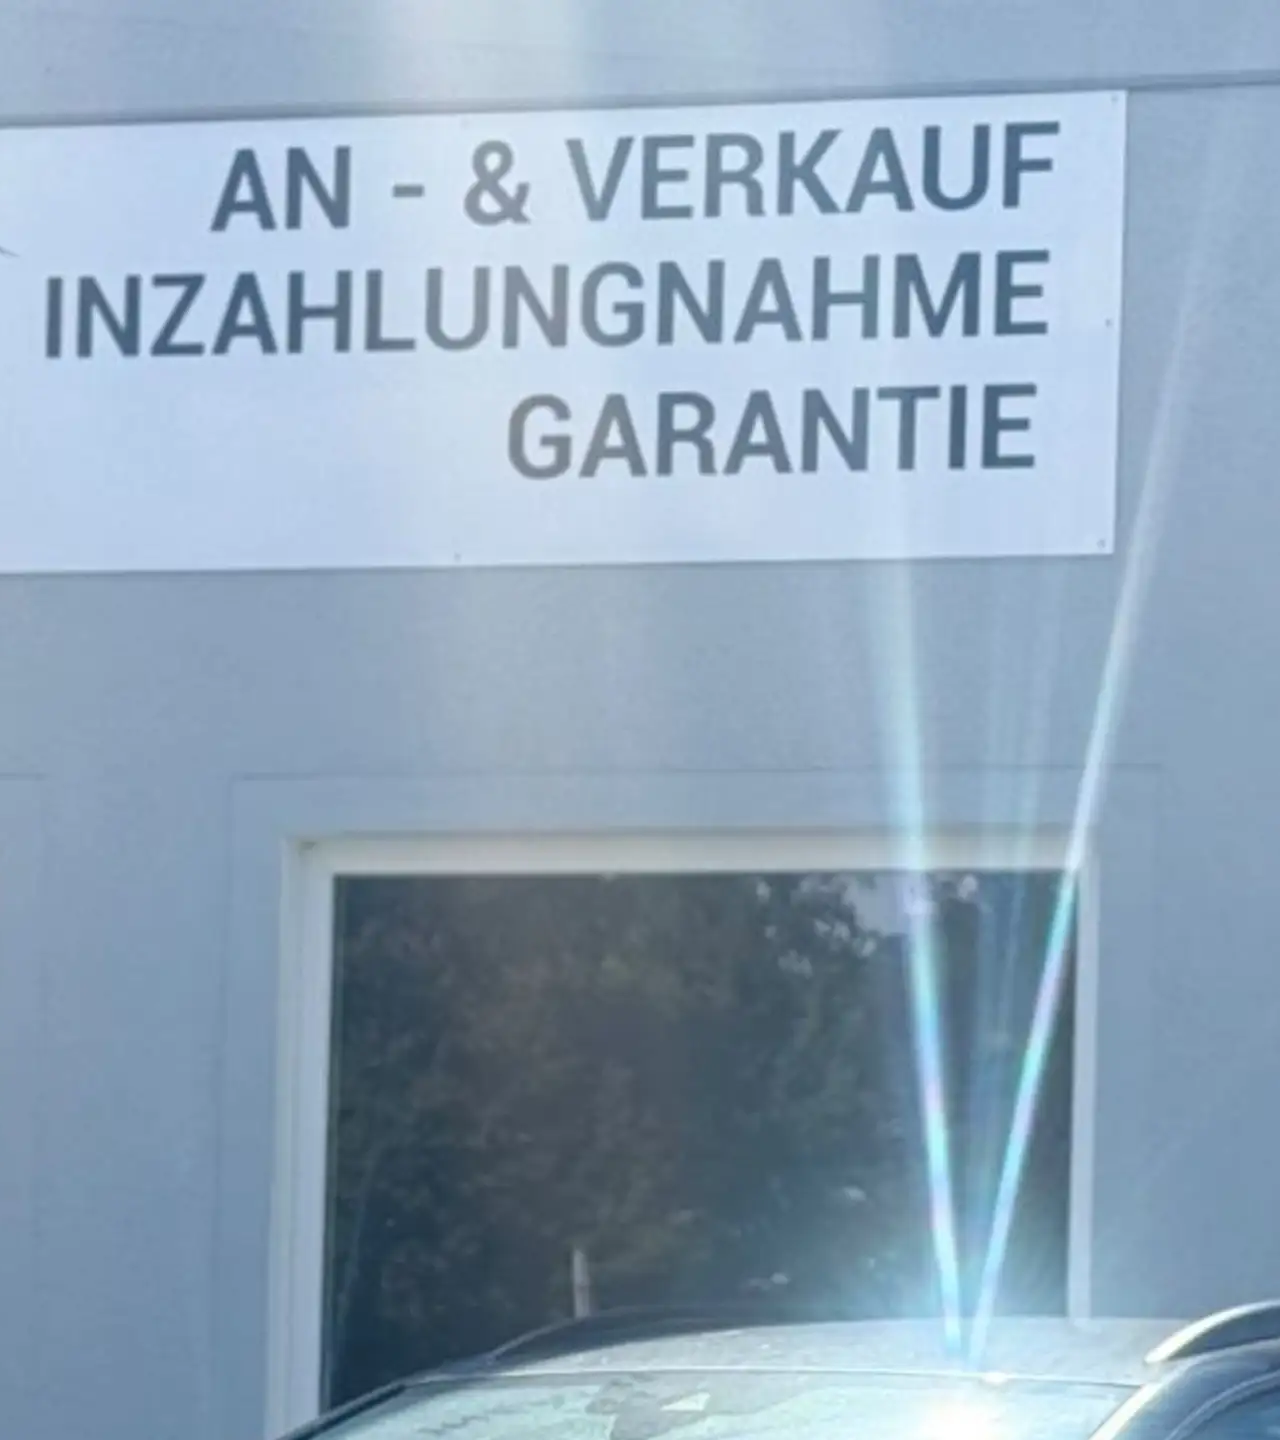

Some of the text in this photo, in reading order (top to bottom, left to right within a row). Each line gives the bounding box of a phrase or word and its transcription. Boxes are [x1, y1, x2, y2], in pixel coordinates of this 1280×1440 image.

[210, 121, 1061, 232] AN - & VERKAUF
[44, 249, 1052, 359] INZAHLUNGNAHME
[507, 383, 1038, 480] GARANTIE
